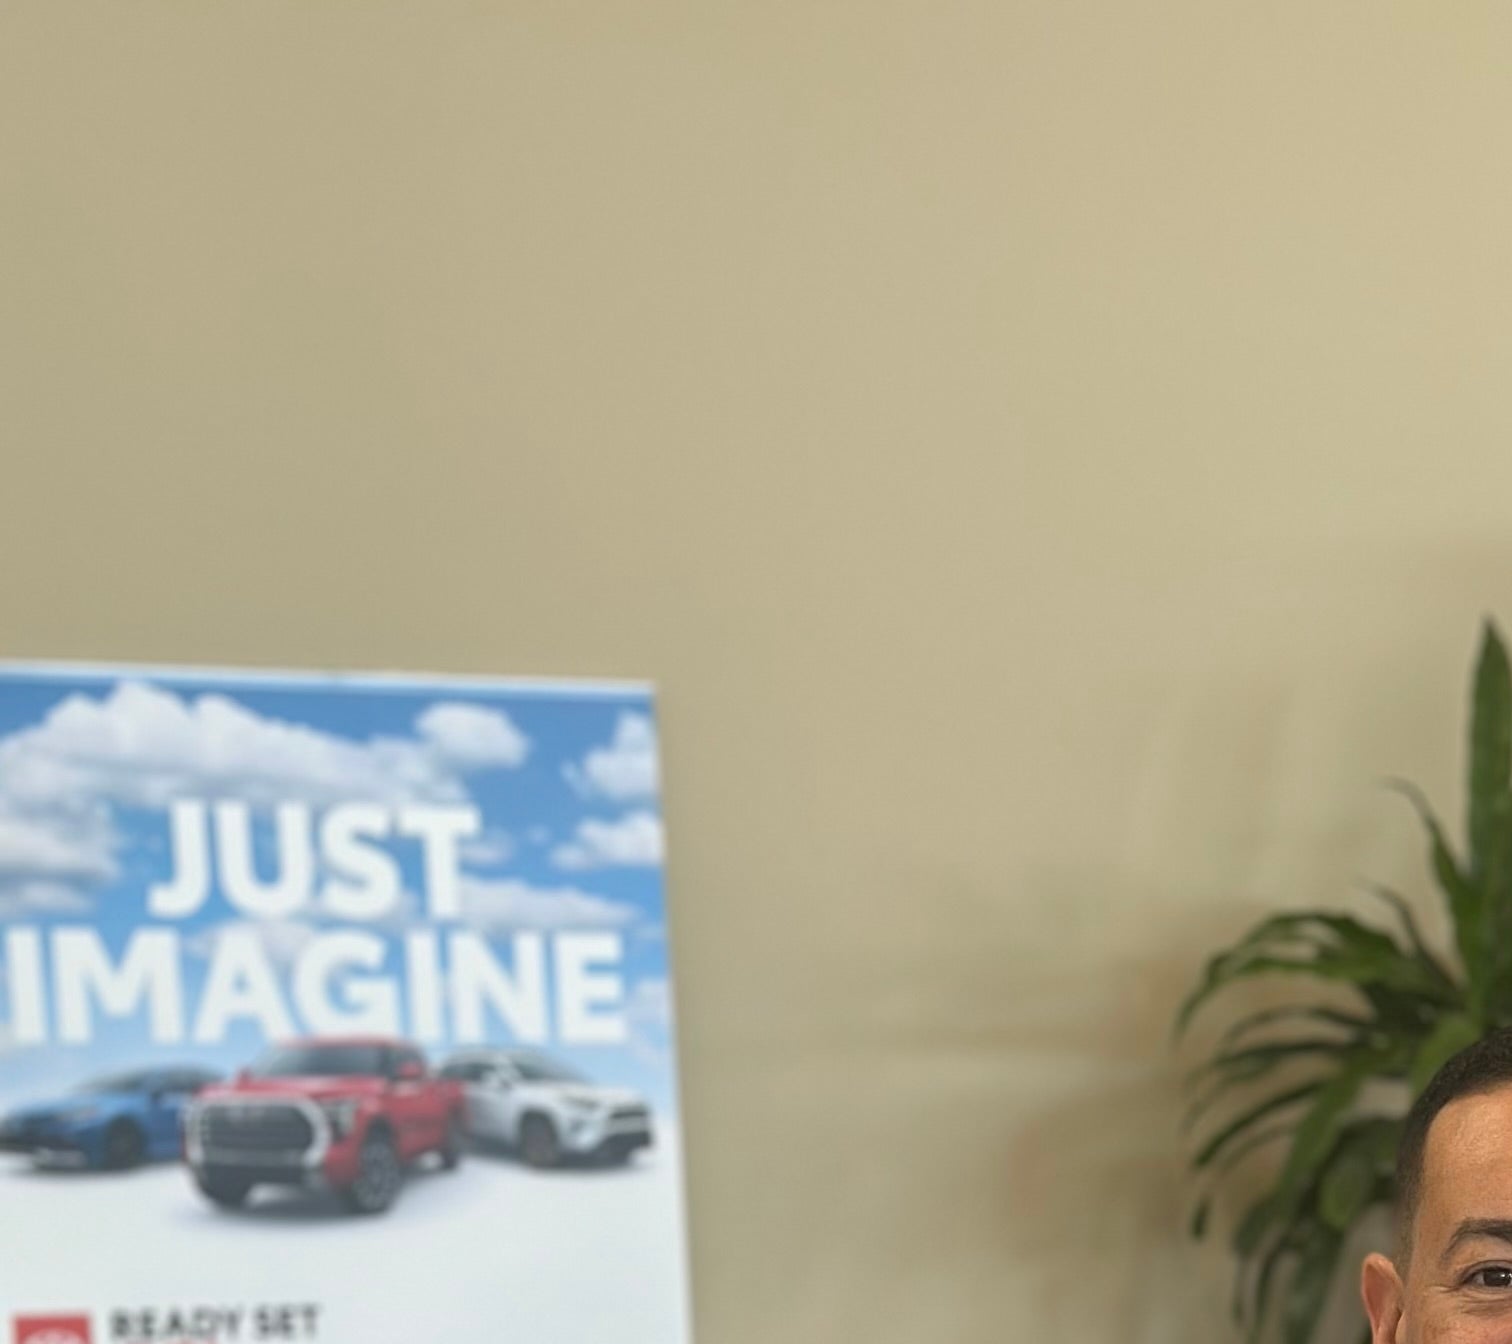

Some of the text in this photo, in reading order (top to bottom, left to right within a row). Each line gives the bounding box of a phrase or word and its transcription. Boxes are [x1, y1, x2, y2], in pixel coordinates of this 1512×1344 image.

[147, 799, 481, 920] JUST
[4, 926, 628, 1047] IMAGINE
[110, 1302, 320, 1340] READY SET
